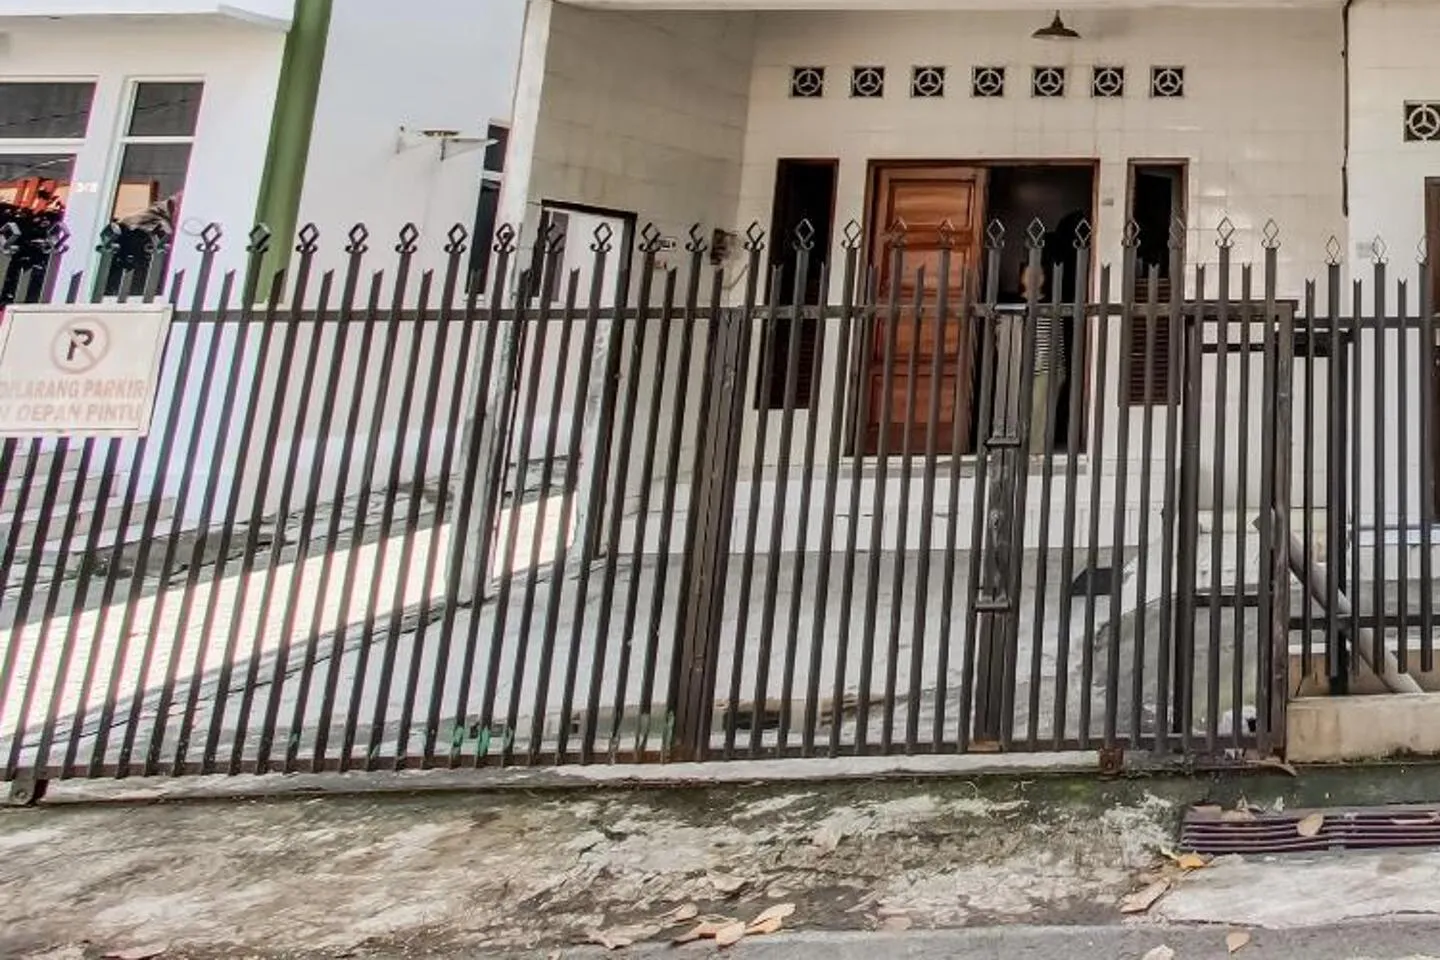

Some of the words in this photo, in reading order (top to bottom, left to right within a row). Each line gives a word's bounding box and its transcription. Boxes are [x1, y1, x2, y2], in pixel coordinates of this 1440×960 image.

[83, 378, 145, 398] PARKIR
[16, 403, 82, 422] DEPAN
[85, 403, 142, 422] PINTU
